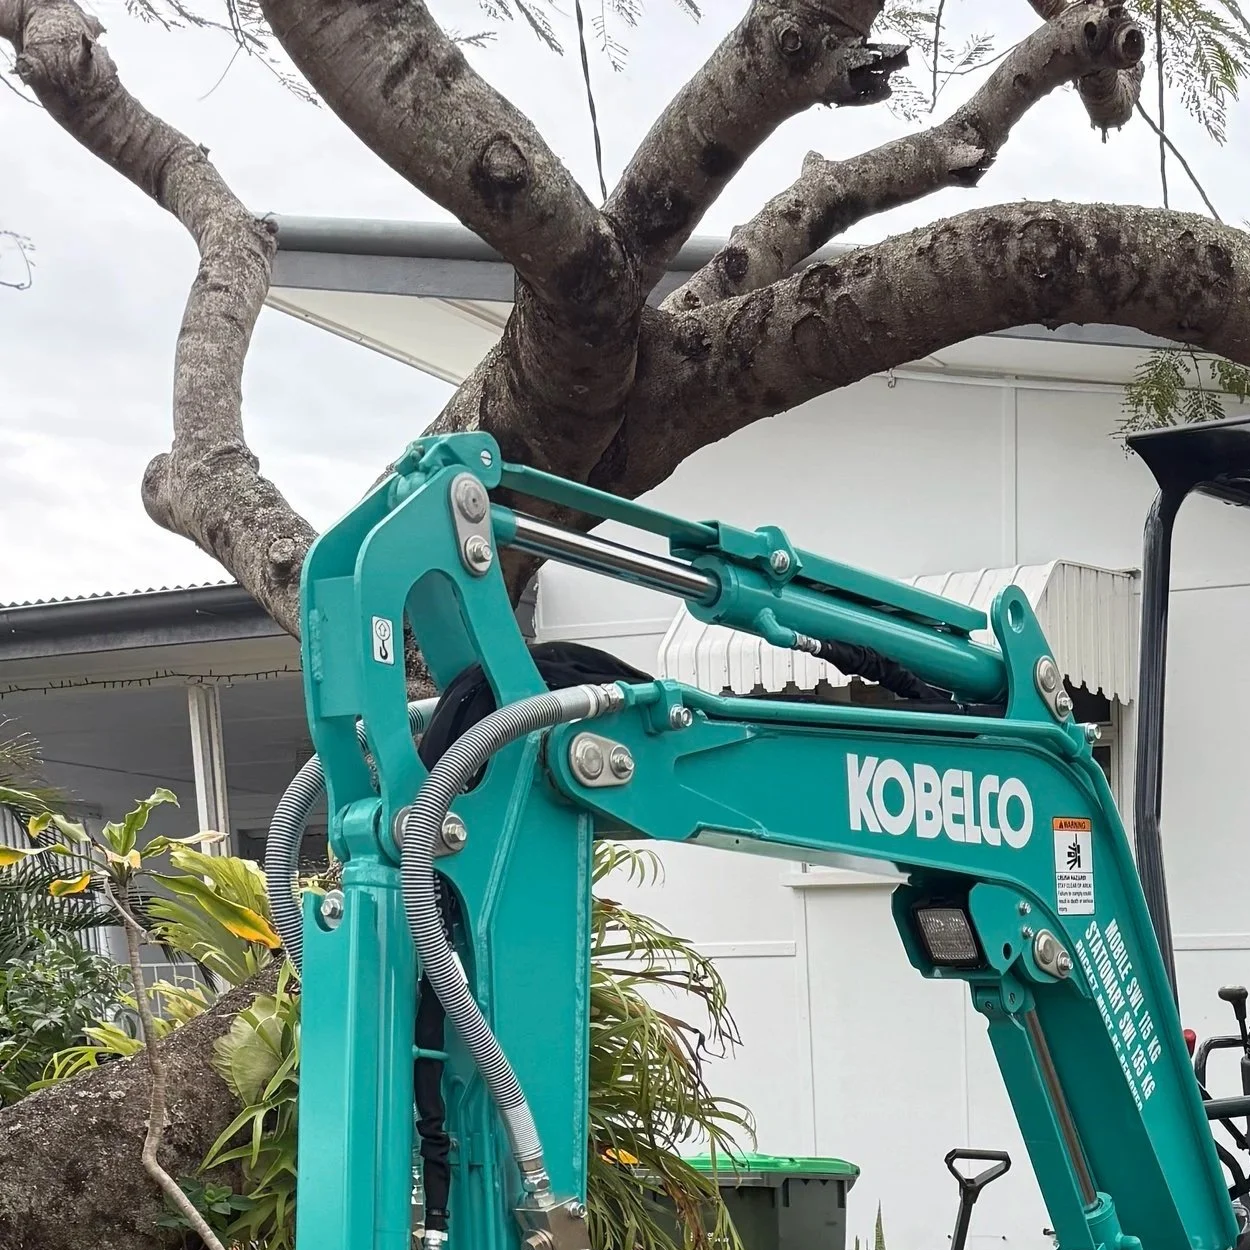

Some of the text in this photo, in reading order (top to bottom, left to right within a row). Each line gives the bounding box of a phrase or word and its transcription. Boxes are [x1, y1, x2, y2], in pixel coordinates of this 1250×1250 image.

[847, 753, 1034, 849] KOBELCO
[1064, 820, 1086, 829] WARNING
[1085, 920, 1156, 1101] STATIONARY SWL 135 KG
[1104, 918, 1162, 1065] MOBILE SWL 115 KG
